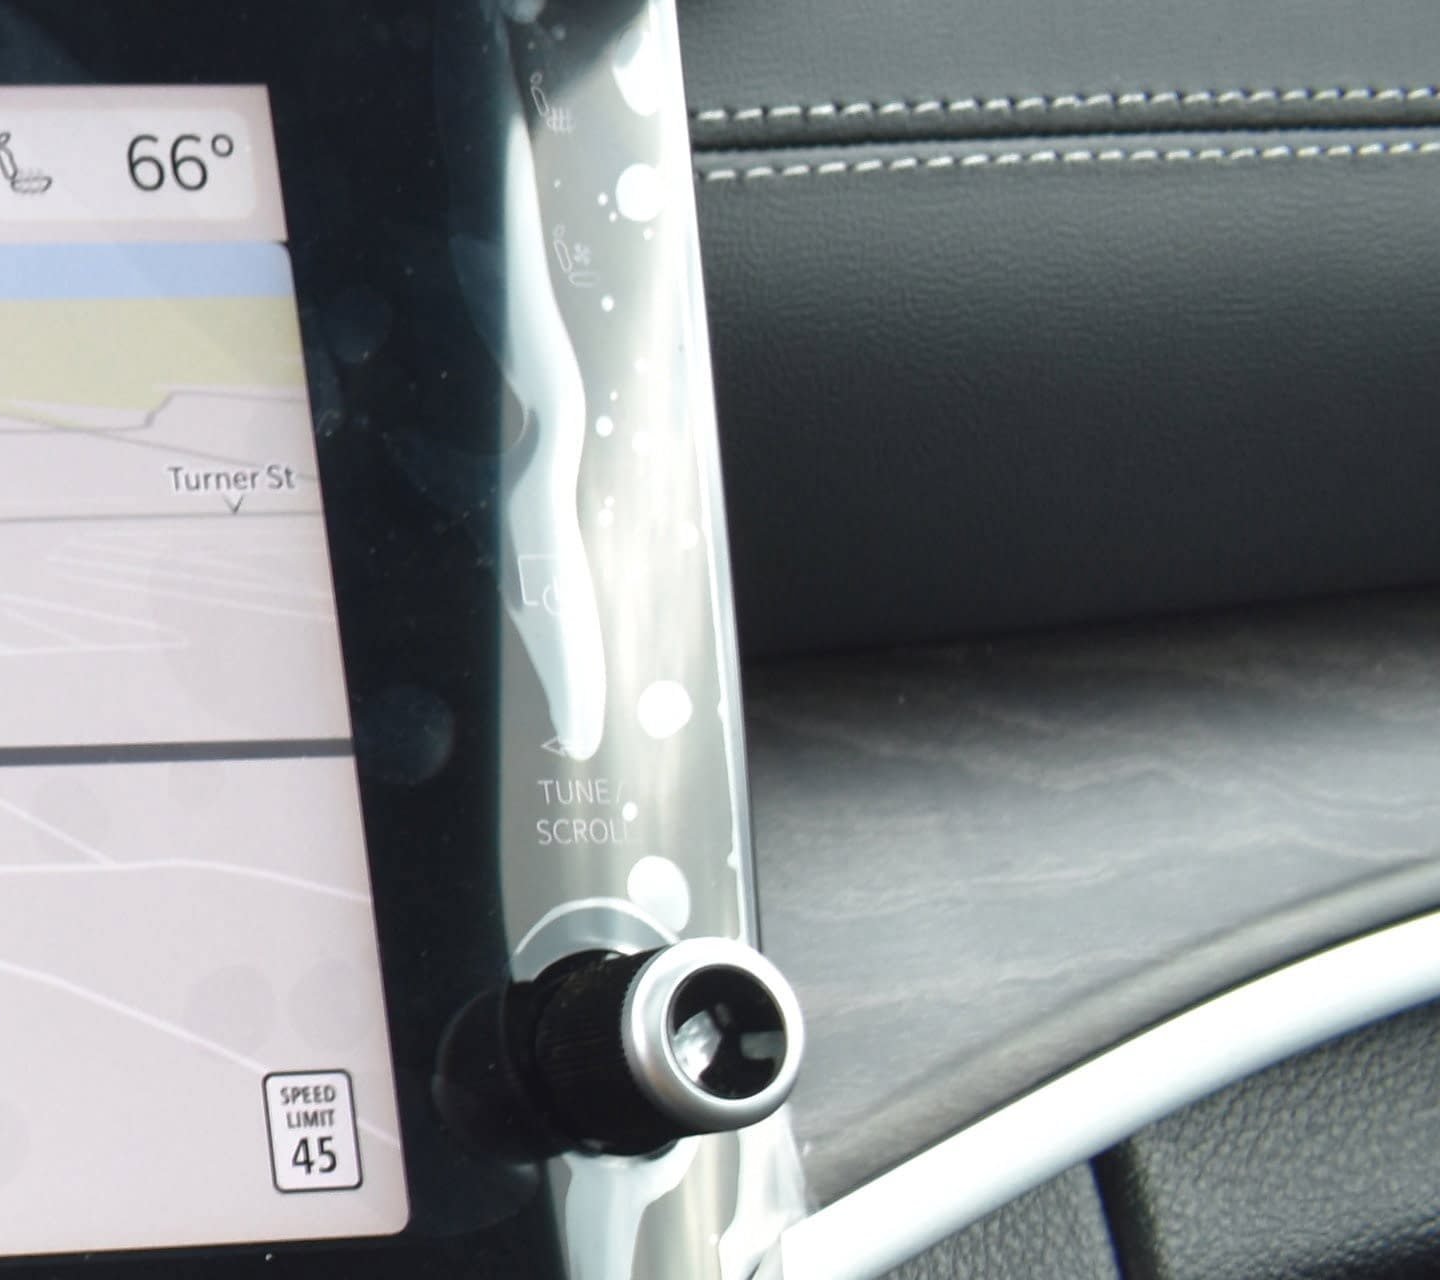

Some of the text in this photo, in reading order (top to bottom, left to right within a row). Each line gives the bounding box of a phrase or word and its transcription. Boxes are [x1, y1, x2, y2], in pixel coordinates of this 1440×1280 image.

[126, 133, 234, 192] 66°
[167, 464, 295, 491] Turner St
[280, 1085, 336, 1106] SPEED
[286, 1109, 335, 1129] LIMIT
[292, 1136, 337, 1175] 45
